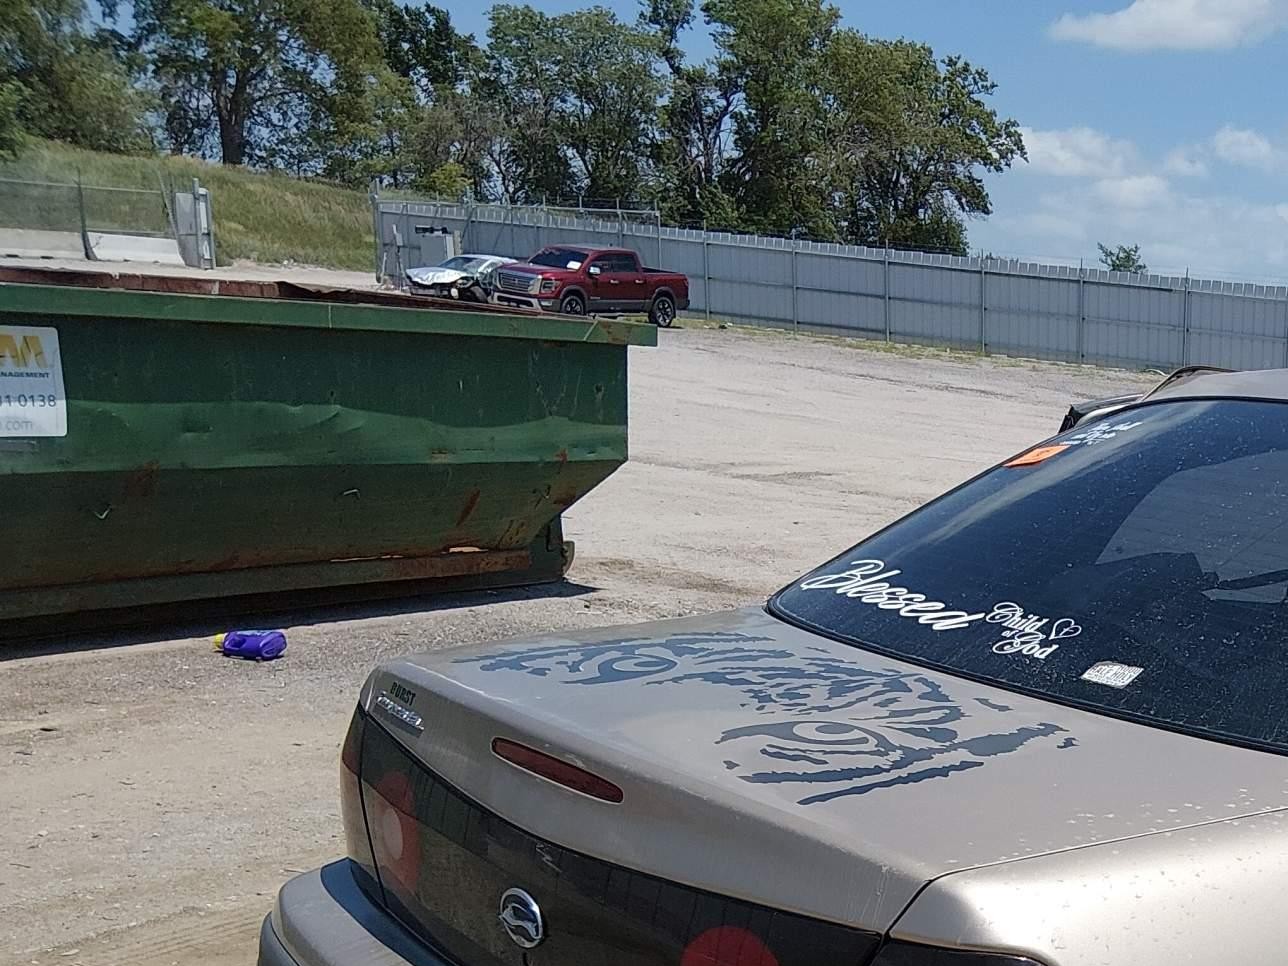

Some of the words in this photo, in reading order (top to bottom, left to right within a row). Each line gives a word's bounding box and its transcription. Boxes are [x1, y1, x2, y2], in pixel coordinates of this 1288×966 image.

[0, 371, 50, 379] NAGEMENT
[17, 394, 57, 408] 0138
[800, 559, 986, 631] Blessed
[985, 601, 1050, 633] Child
[1001, 629, 1020, 638] of
[992, 630, 1060, 659] God
